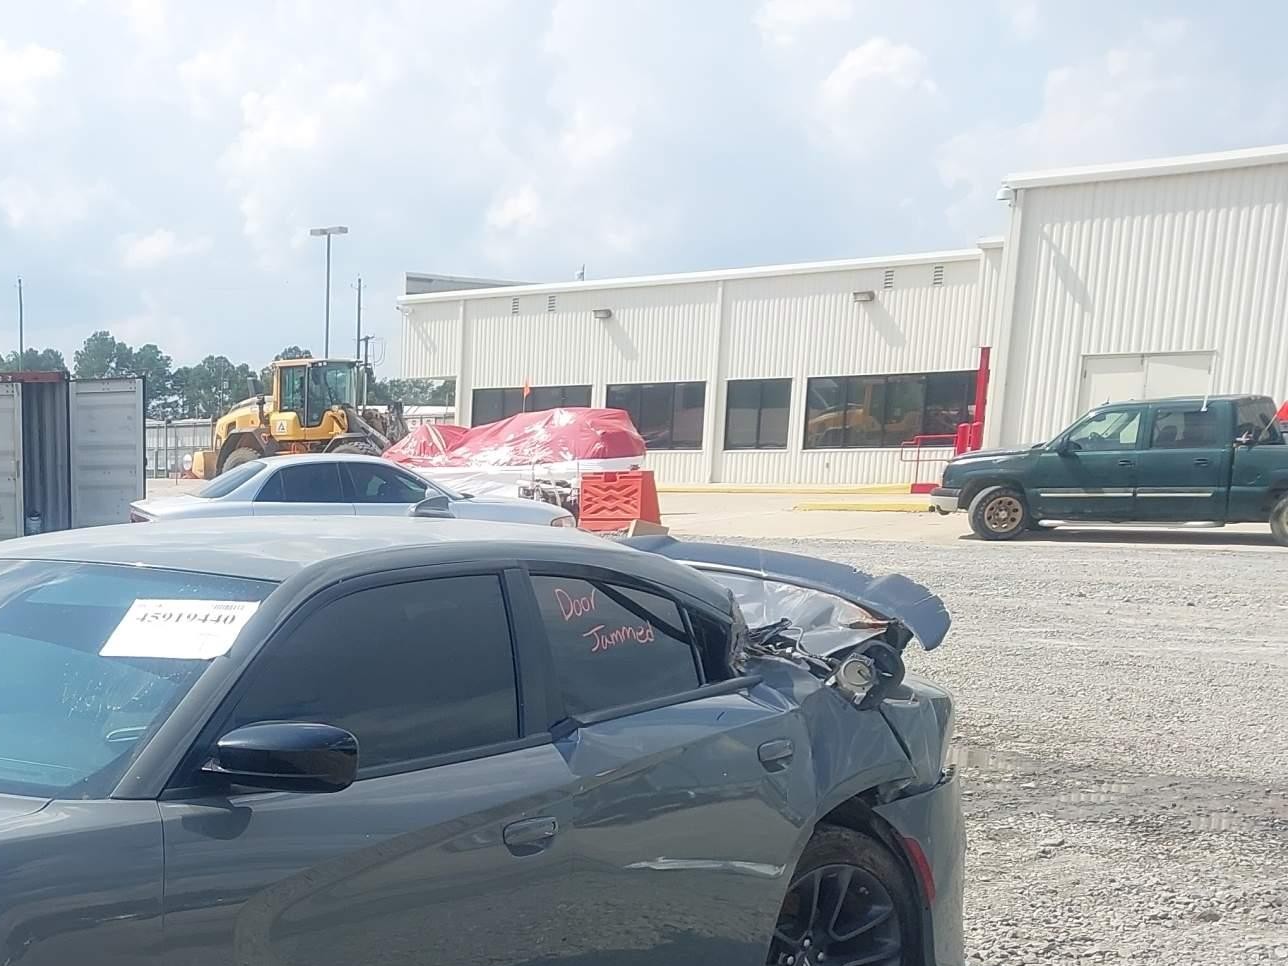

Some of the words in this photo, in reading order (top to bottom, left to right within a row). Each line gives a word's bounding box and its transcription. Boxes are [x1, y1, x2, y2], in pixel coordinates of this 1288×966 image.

[135, 612, 237, 625] 45919440
[554, 588, 597, 621] Door
[582, 619, 655, 652] Jammed
